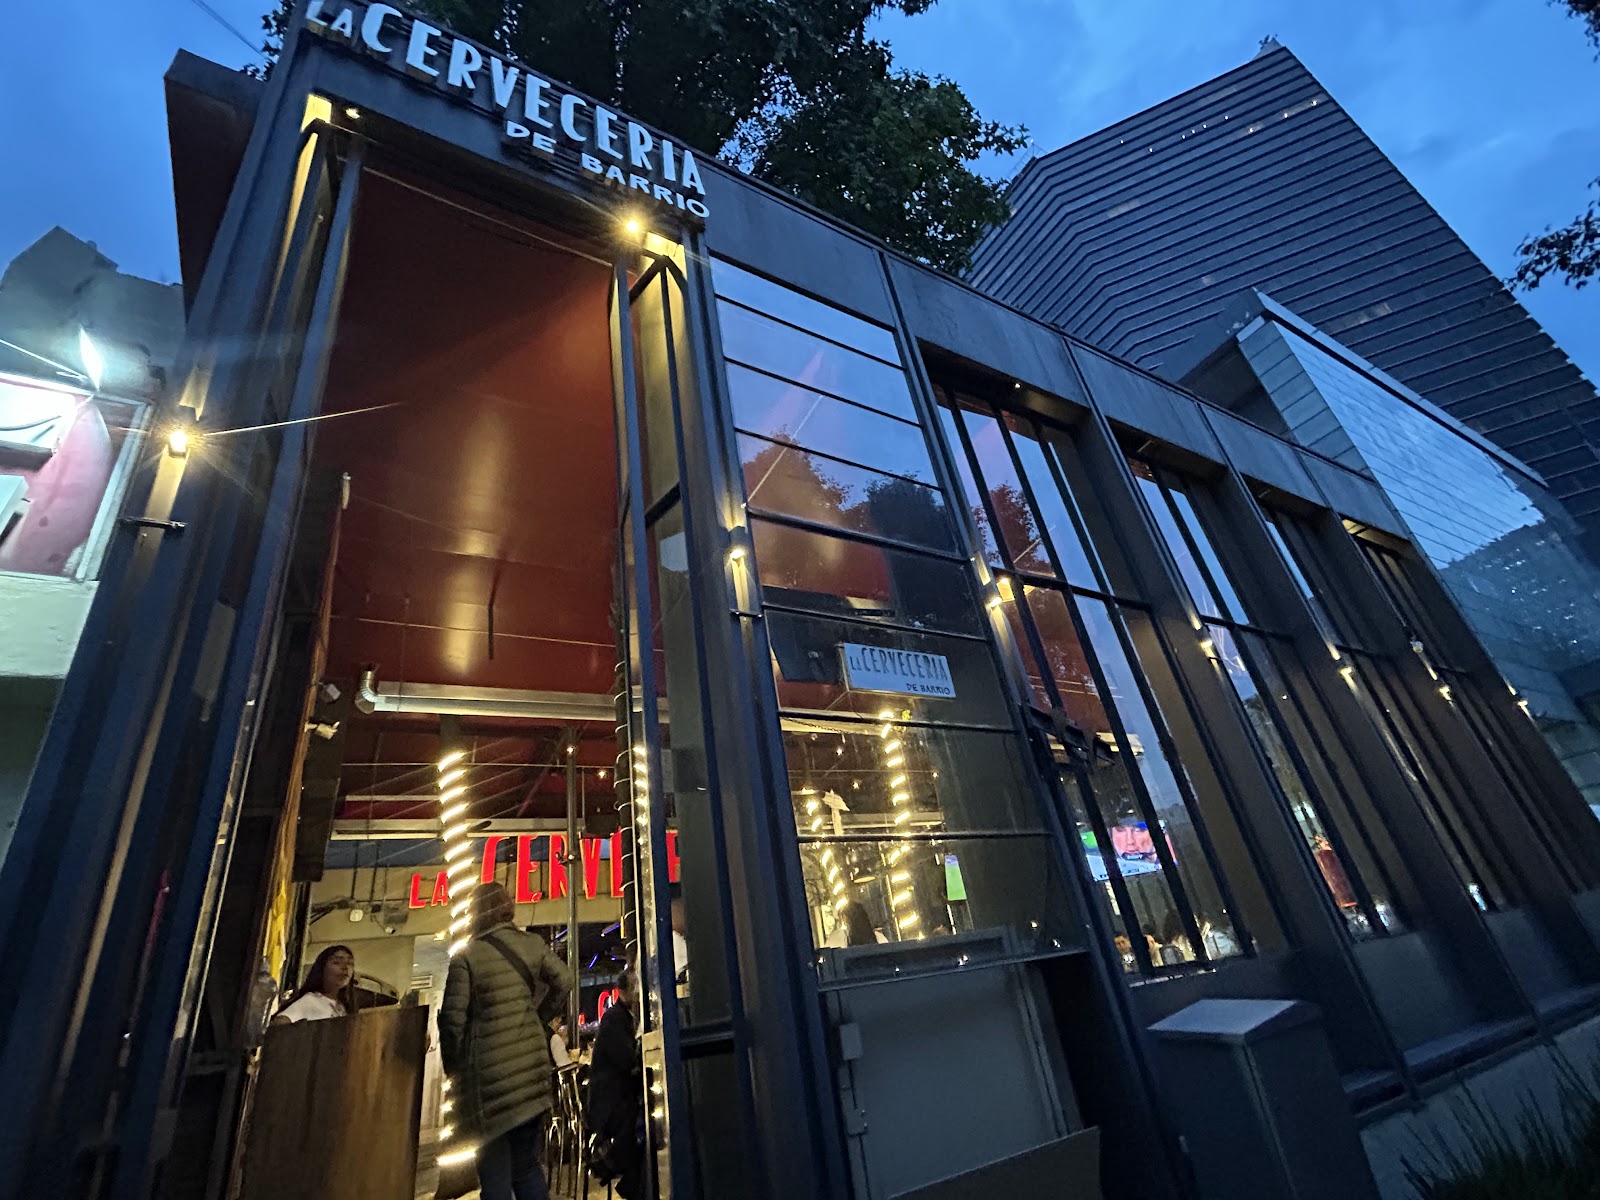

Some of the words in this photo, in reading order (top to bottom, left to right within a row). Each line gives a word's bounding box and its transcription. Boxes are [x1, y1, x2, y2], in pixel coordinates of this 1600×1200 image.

[305, 0, 351, 38] LA
[361, 3, 706, 196] CERVECERIA
[506, 120, 558, 154] DE
[581, 152, 711, 219] BARRIO
[861, 647, 949, 681] CERVECERIA
[906, 682, 918, 693] DE
[920, 684, 951, 696] BARRIO
[408, 870, 449, 908] LA
